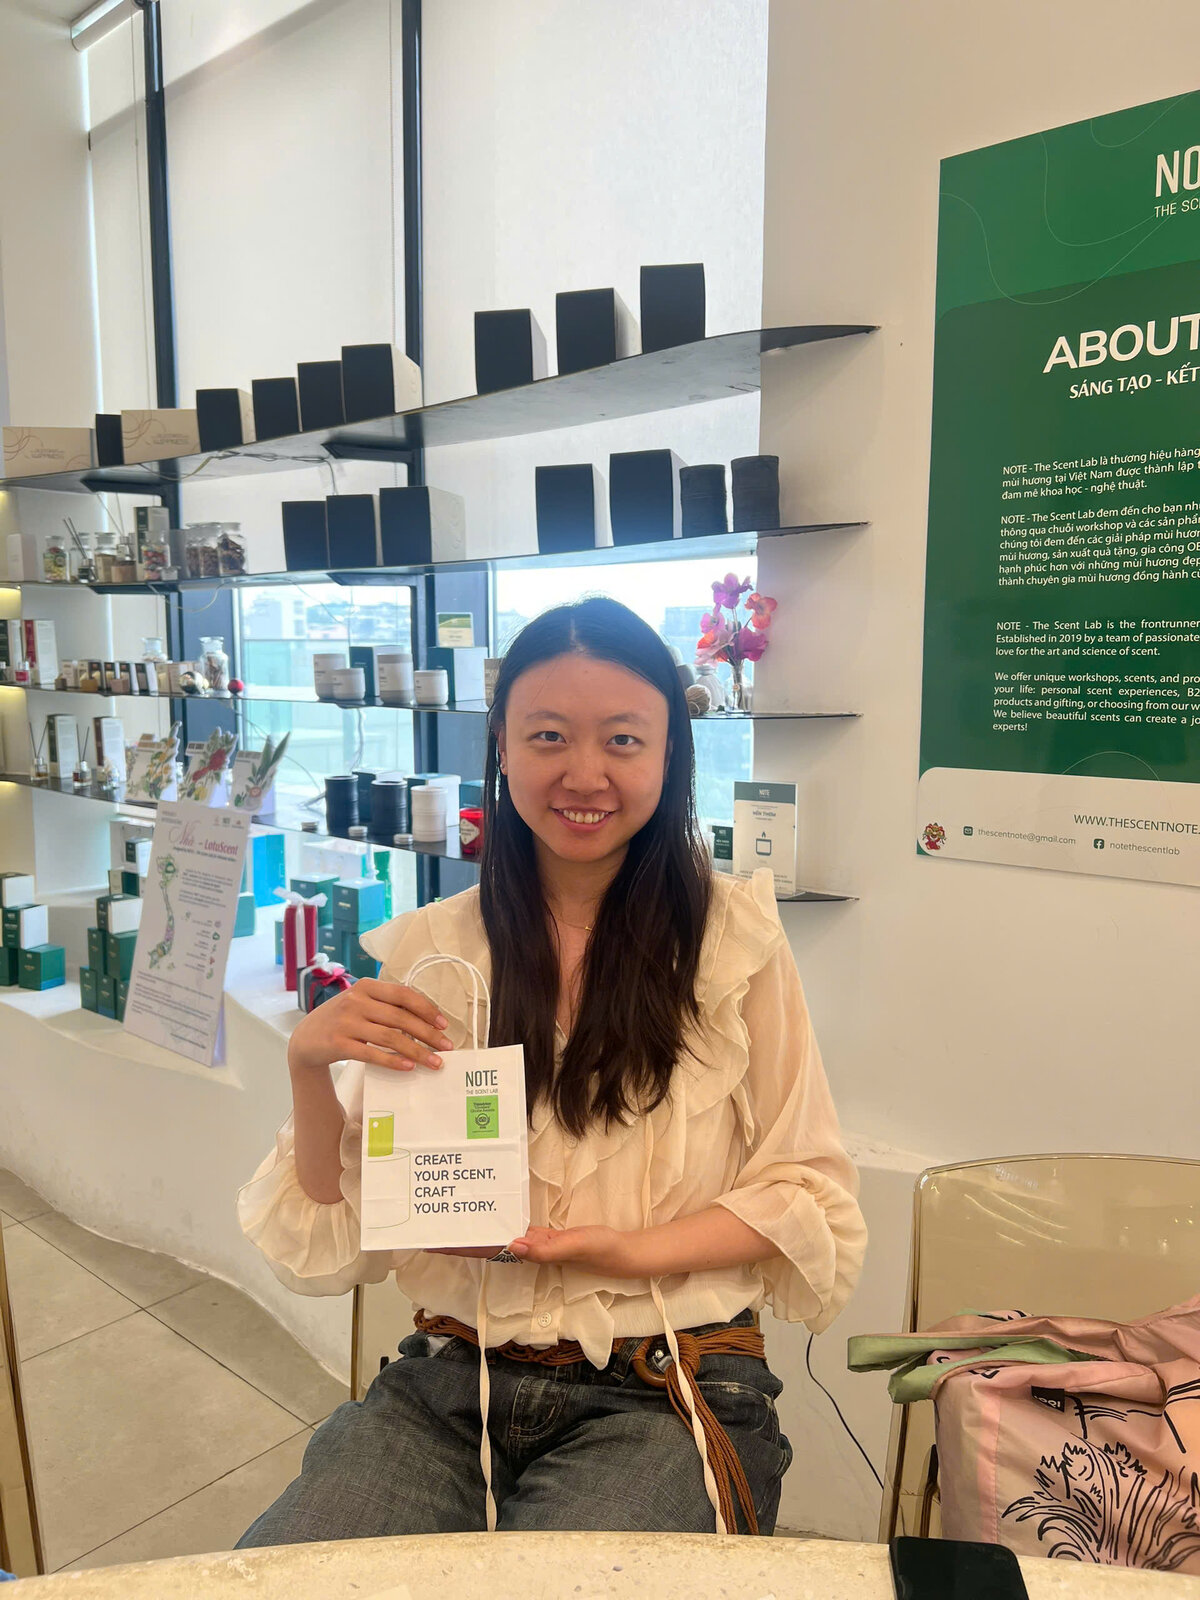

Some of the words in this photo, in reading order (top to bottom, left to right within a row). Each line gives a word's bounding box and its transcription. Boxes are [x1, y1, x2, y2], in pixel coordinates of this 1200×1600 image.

[1154, 202, 1176, 218] THE
[1181, 198, 1200, 212] SC
[1042, 312, 1200, 373] ABOUT
[1070, 379, 1113, 399] SÁNG
[1117, 374, 1151, 394] TẠO
[1167, 362, 1200, 385] KẾT
[1003, 464, 1027, 475] NOTE
[1034, 463, 1051, 472] The
[1053, 460, 1079, 470] Scent
[1081, 458, 1098, 467] Lab
[1100, 456, 1108, 465] là
[1110, 454, 1146, 464] thương
[1150, 450, 1172, 461] hiệu
[1003, 478, 1019, 487] mùi
[1022, 476, 1052, 485] hương
[1055, 474, 1066, 484] tại
[1069, 472, 1087, 482] Việt
[1090, 470, 1112, 479] Nam
[1116, 467, 1141, 478] được
[1144, 463, 1174, 474] thành
[1178, 461, 1194, 471] lập
[1002, 491, 1022, 500] đam
[1024, 489, 1038, 498] mê
[1040, 487, 1062, 497] khoa
[1065, 485, 1082, 495] học
[1091, 481, 1116, 494] nghệ
[1118, 479, 1147, 491] thuật.
[1001, 515, 1025, 524] NOTE
[1032, 514, 1048, 522] The
[1050, 512, 1076, 521] Scent
[1078, 510, 1095, 519] Lab
[1097, 508, 1118, 517] đem
[1121, 506, 1140, 516] đến
[1142, 504, 1160, 514] cho
[1163, 502, 1182, 514] bạn
[1001, 528, 1026, 538] thông
[1029, 527, 1046, 536] qua
[1076, 520, 1123, 532] workshop
[1126, 518, 1136, 528] và
[1139, 517, 1155, 527] các
[1158, 514, 1175, 526] sản
[1000, 539, 1028, 550] chúng
[1030, 538, 1042, 547] tôi
[1044, 536, 1064, 546] đem
[1067, 535, 1084, 545] đến
[1087, 533, 1103, 543] các
[1106, 532, 1123, 545] giải
[1126, 530, 1150, 543] pháp
[1154, 528, 1173, 539] mùi
[1000, 552, 1016, 561] mùi
[1019, 550, 1050, 561] hương,
[1052, 547, 1068, 558] sản
[1141, 544, 1156, 556] gia
[1159, 542, 1184, 553] công
[1000, 563, 1021, 574] hạnh
[1024, 562, 1046, 574] phúc
[1050, 560, 1068, 570] hơn
[1071, 559, 1085, 569] với
[1123, 557, 1142, 567] mùi
[1146, 556, 1178, 568] hương
[1000, 574, 1024, 585] thành
[1026, 573, 1059, 586] chuyên
[1062, 572, 1075, 584] gia
[1078, 571, 1096, 582] mùi
[1099, 571, 1130, 584] hương
[1162, 568, 1188, 579] hành
[996, 622, 1021, 630] NOTE
[1033, 621, 1049, 630] The
[1054, 621, 1079, 629] Scent
[1085, 620, 1101, 629] Lab
[1107, 620, 1114, 628] is
[1120, 620, 1136, 628] the
[1141, 619, 1200, 628] frontrunner
[996, 634, 1046, 643] Established
[1049, 635, 1056, 643] in
[1059, 634, 1082, 642] 2019
[1084, 633, 1095, 644] by
[1133, 632, 1143, 642] of
[1145, 632, 1200, 644] passionate
[996, 647, 1013, 655] love
[1016, 647, 1028, 655] for
[1031, 647, 1045, 655] the
[1062, 646, 1079, 655] and
[1082, 647, 1116, 655] science
[1119, 646, 1129, 655] of
[1132, 648, 1160, 656] scent.
[995, 672, 1008, 680] We
[1011, 672, 1031, 680] offer
[1034, 673, 1066, 683] unique
[1069, 673, 1121, 684] workshops,
[1124, 674, 1157, 684] scents,
[1160, 674, 1179, 683] and
[1183, 675, 1200, 685] pro
[994, 687, 1013, 695] your
[1020, 685, 1035, 694] life:
[1042, 686, 1080, 695] personal
[1118, 687, 1180, 697] experiences,
[1187, 688, 1200, 697] B2
[994, 698, 1032, 707] products
[1054, 699, 1085, 709] gifting,
[1100, 700, 1143, 711] choosing
[1146, 700, 1169, 710] from
[994, 710, 1008, 718] We
[1011, 710, 1042, 719] believe
[1046, 712, 1087, 720] beautiful
[1091, 713, 1120, 721] scents
[1124, 715, 1142, 723] can
[993, 723, 1027, 732] experts!
[978, 828, 1076, 845] thescentnote@gmail.com
[1110, 841, 1180, 855] notethescentlab
[466, 1070, 498, 1087] NOTE
[415, 1154, 462, 1165] CREATE
[414, 1170, 449, 1181] YOUR
[453, 1169, 496, 1180] SCENT,
[415, 1186, 455, 1198] CRAFT
[414, 1202, 449, 1214] YOUR
[453, 1201, 496, 1213] STORY.
[1034, 1396, 1060, 1407] OQI
